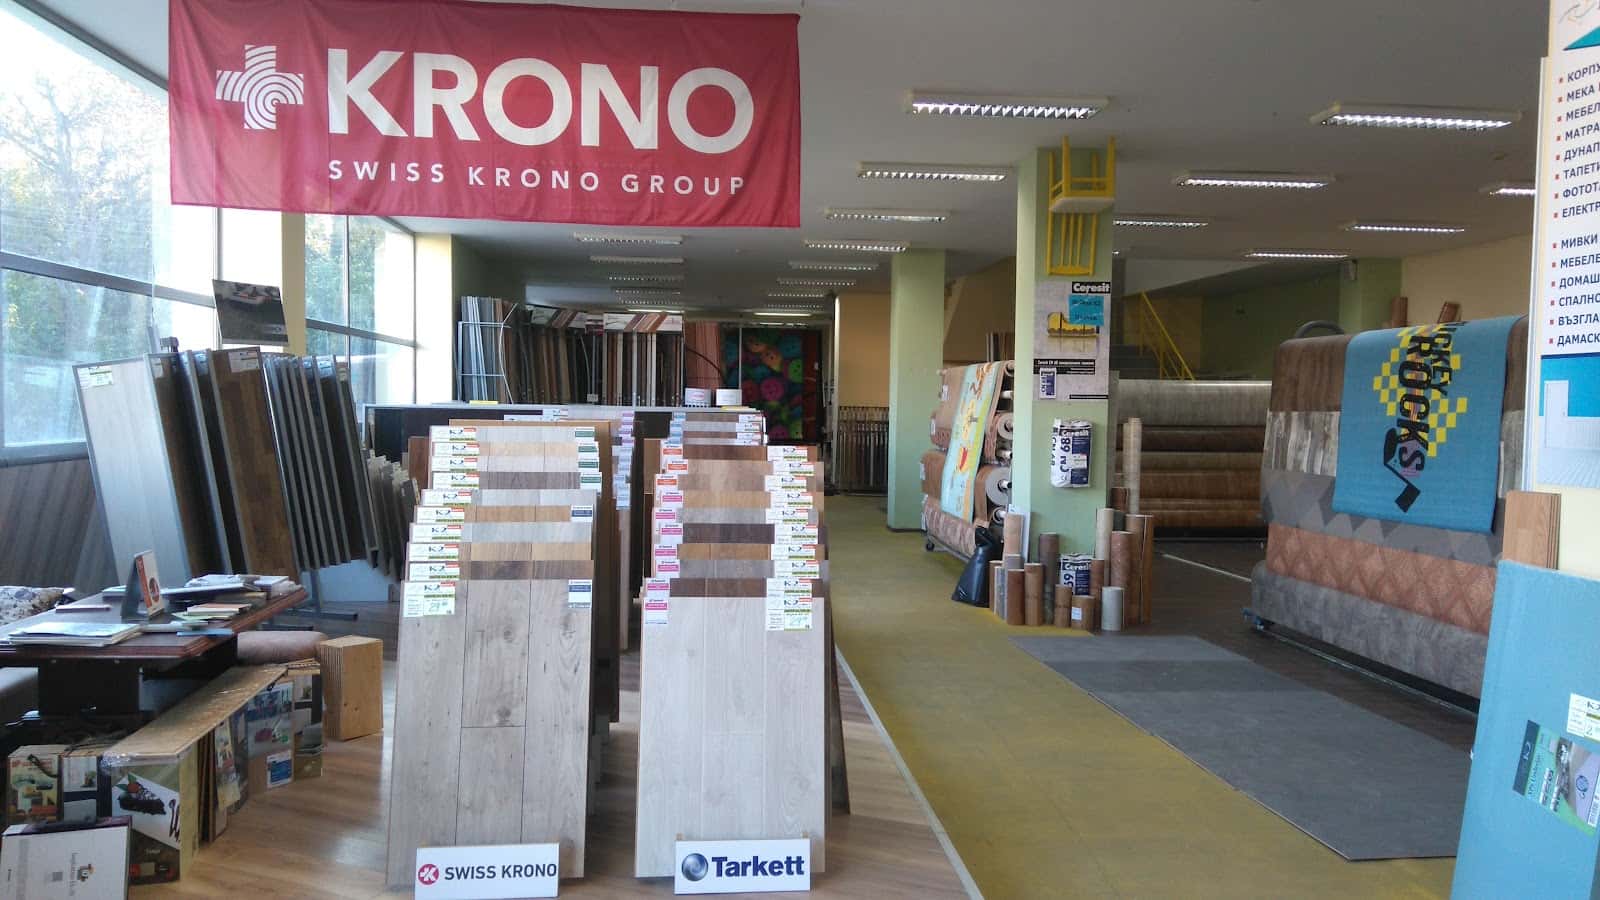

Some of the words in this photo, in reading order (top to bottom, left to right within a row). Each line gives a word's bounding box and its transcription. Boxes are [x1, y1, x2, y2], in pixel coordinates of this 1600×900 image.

[327, 47, 756, 155] KRONO
[1566, 84, 1595, 102] МЕКА
[1565, 122, 1600, 142] МАТРА
[328, 159, 445, 184] SWISS
[468, 166, 601, 192] KRONO
[620, 174, 746, 196] GROUP
[1561, 233, 1598, 249] МИВКИ
[1558, 313, 1600, 326] ВЪЗГЛА
[1557, 332, 1600, 348] ДАМАСК
[1397, 336, 1432, 472] ROCKS
[1060, 438, 1070, 453] 68
[444, 865, 497, 881] SWISS
[501, 863, 557, 879] KRONO
[711, 855, 805, 878] Tarkett
